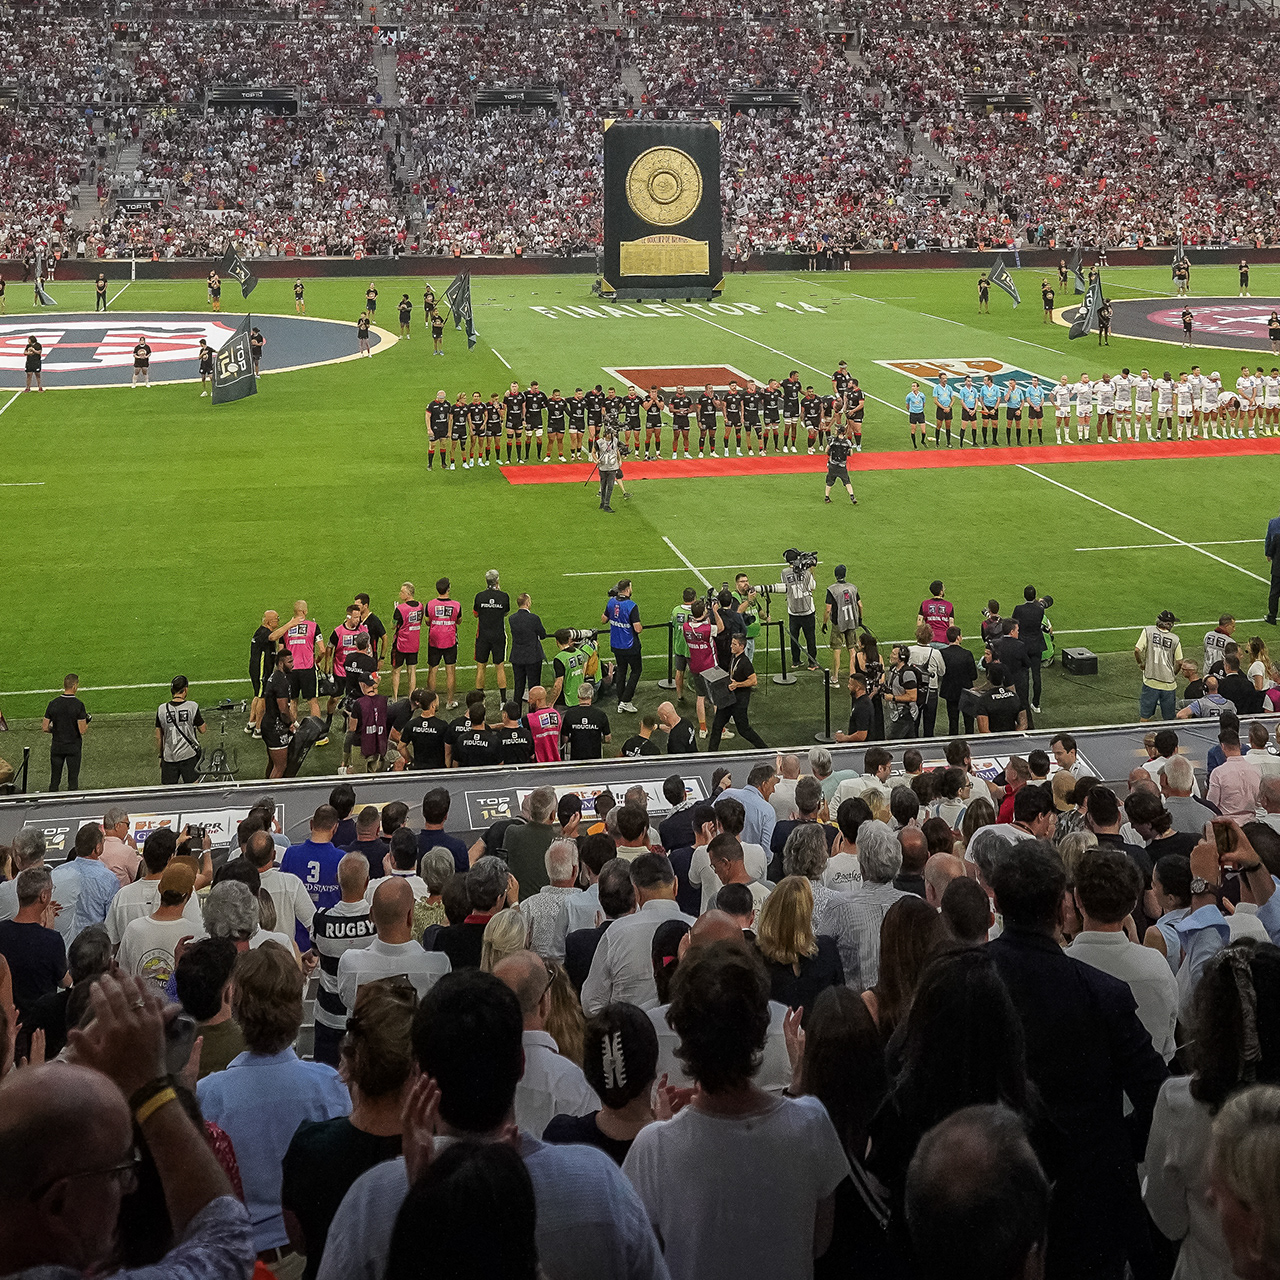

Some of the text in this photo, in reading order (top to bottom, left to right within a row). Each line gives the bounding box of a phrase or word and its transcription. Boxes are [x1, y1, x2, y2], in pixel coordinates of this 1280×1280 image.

[529, 301, 827, 319] FINALE TOP 14
[237, 340, 247, 371] TOP
[991, 691, 1015, 700] FIDUCIAL
[412, 726, 437, 734] FIDUCIAL
[476, 797, 510, 805] TOP
[481, 805, 511, 819] 14
[306, 860, 320, 883] 3
[313, 883, 339, 892] STATES
[325, 920, 375, 938] RUGBY
